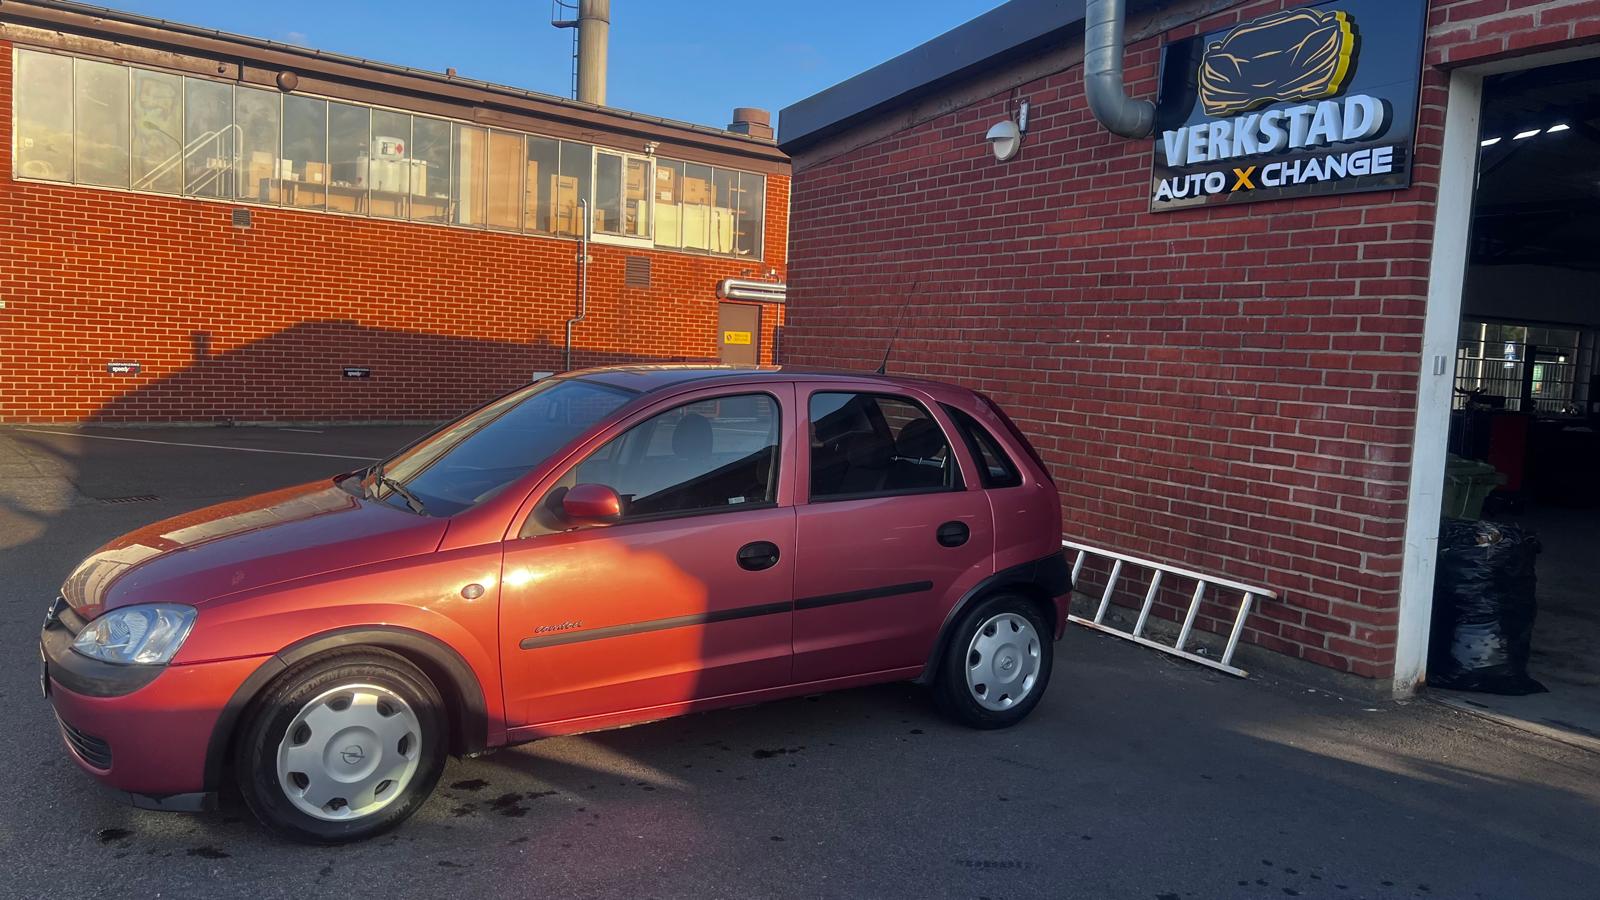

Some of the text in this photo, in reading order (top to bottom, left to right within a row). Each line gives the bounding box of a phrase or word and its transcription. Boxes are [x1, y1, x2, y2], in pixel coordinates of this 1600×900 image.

[1163, 95, 1384, 167] VERKSTAD
[1154, 146, 1393, 201] AUTO X CHANGE
